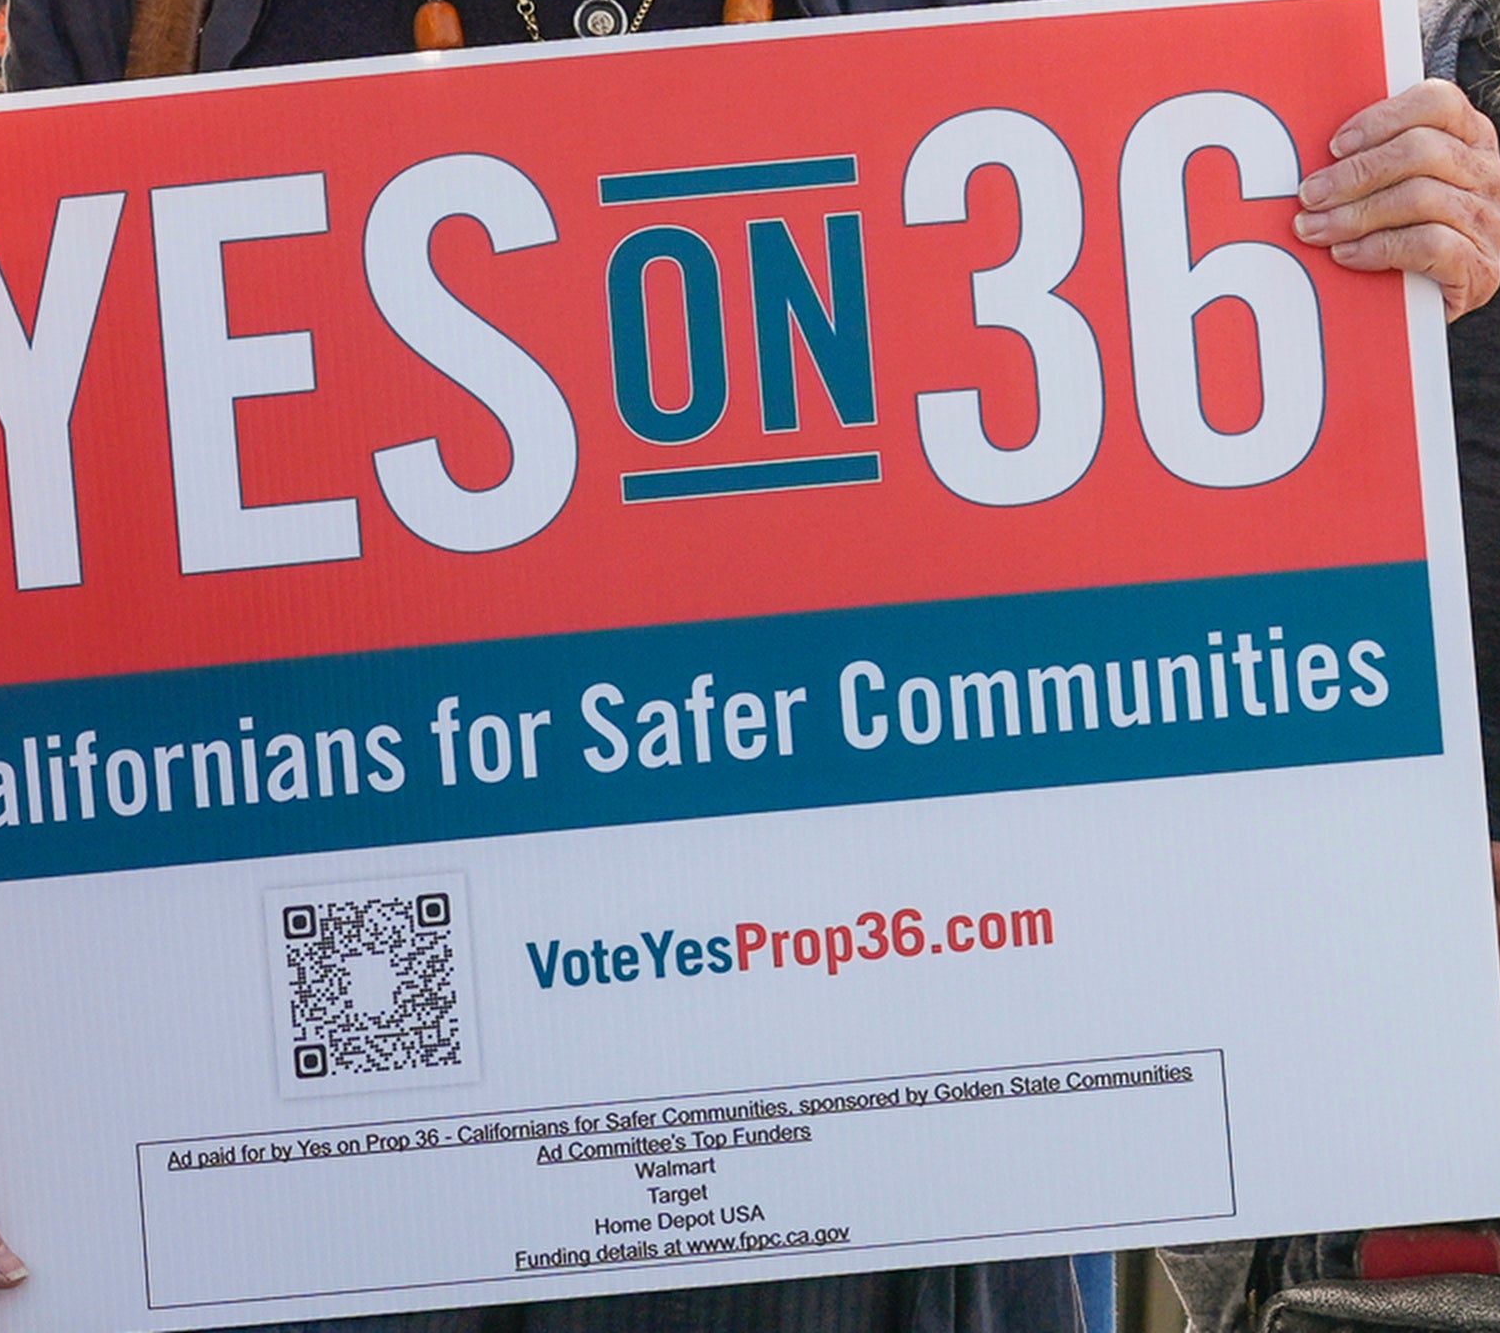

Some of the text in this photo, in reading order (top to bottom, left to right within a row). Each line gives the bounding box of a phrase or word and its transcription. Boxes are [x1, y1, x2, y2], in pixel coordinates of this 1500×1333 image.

[605, 211, 880, 446] ON
[899, 87, 1328, 508] 36
[430, 695, 553, 787] for
[579, 672, 808, 775] Safer
[838, 625, 1391, 751] Communities
[525, 905, 1056, 990] VoteYesProp36.com
[167, 1150, 193, 1170] Ad
[198, 1144, 237, 1169] paid
[241, 1142, 267, 1164] for
[270, 1141, 294, 1163] by
[297, 1139, 332, 1159] Yes
[336, 1137, 362, 1156] on
[365, 1132, 411, 1155] Prop
[414, 1128, 440, 1150] 36
[457, 1118, 570, 1145] Californians
[574, 1114, 601, 1135] for
[604, 1109, 657, 1132] Safer
[662, 1097, 795, 1126] Communities,
[798, 1087, 901, 1118] sponsored
[905, 1086, 929, 1109] by
[933, 1079, 1006, 1103] Golden
[1009, 1074, 1062, 1096] State
[1065, 1063, 1194, 1090] Communities
[536, 1123, 812, 1164] Ad Committee's Top Funders
[634, 1156, 716, 1180] Walmart
[595, 1204, 765, 1236] Home Depot USA
[647, 1184, 709, 1207] Target
[515, 1224, 851, 1273] Funding details at www.fppc.ca.gov
